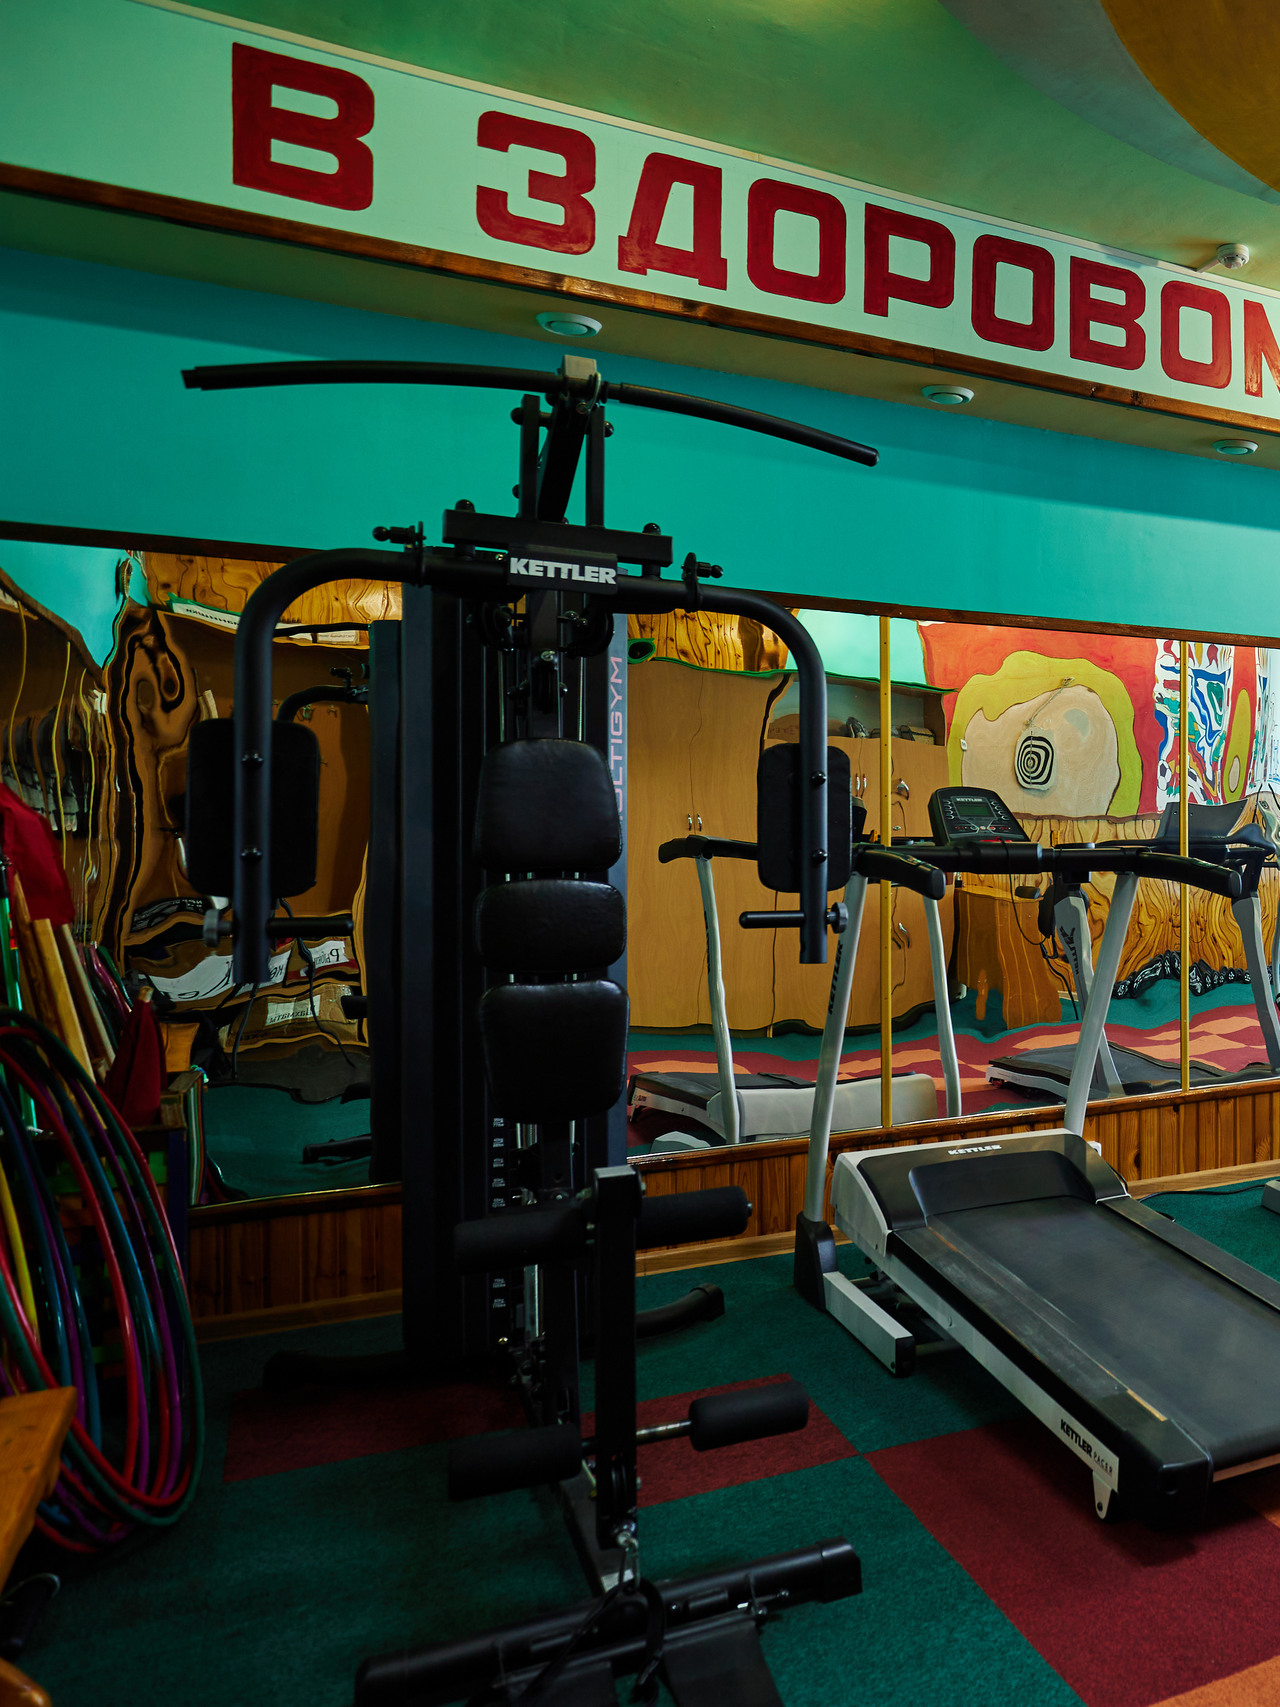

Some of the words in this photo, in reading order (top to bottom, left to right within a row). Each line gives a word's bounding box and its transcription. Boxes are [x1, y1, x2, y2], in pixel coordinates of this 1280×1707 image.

[232, 42, 375, 211] В
[509, 557, 617, 585] KETTLER
[608, 656, 625, 821] ULTIGYM
[947, 1144, 1002, 1155] KETTLER
[1060, 1418, 1092, 1458] KETTLER
